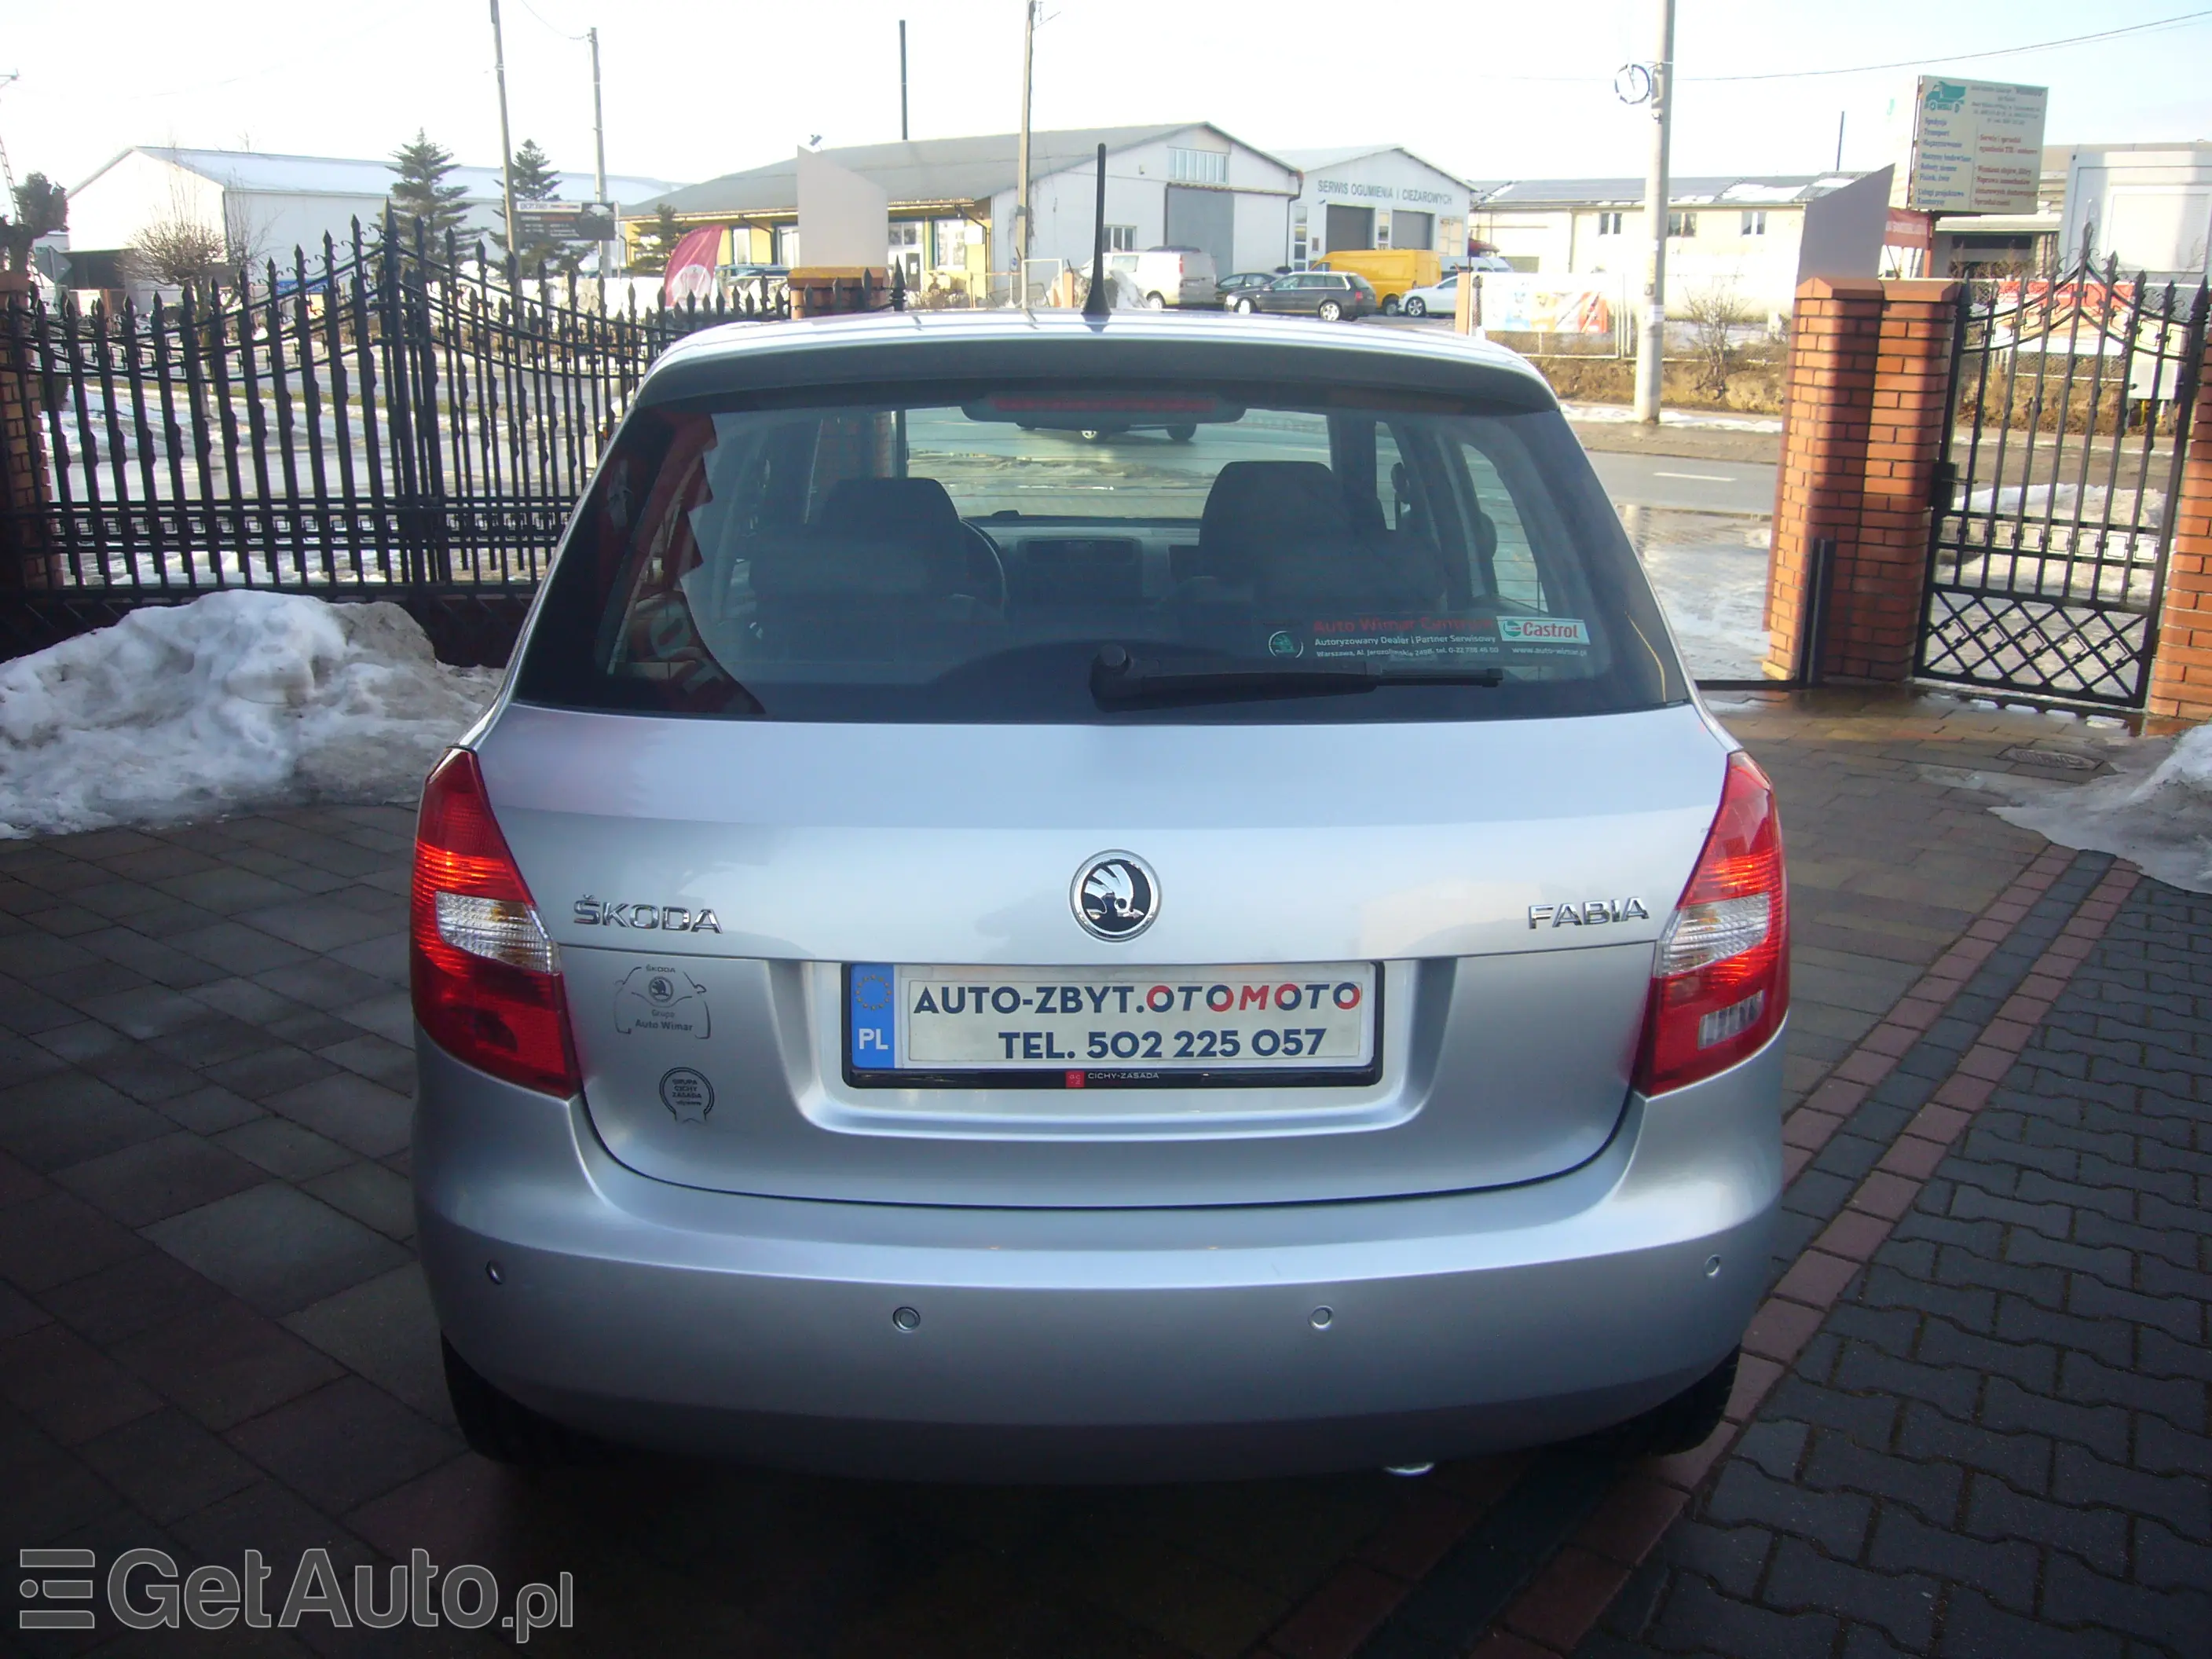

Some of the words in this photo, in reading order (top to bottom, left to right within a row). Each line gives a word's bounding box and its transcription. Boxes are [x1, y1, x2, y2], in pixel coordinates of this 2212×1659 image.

[1317, 179, 1348, 195] SERWIS
[1350, 183, 1393, 199] OGUMIENIA
[1314, 637, 1379, 647] Autoryzowany
[1380, 635, 1410, 645] Dealer
[1416, 635, 1448, 644] Partner
[1449, 634, 1496, 644] Serwisowy
[1522, 621, 1579, 639] Castrol
[573, 895, 723, 934] ŠKODA
[1528, 896, 1650, 929] FABIA
[645, 964, 676, 973] ŠKODA
[913, 982, 1361, 1015] AUTO-ZBYT.OTOMOTO
[635, 1019, 658, 1029] Auto
[661, 1021, 694, 1031] Wimar
[859, 1027, 889, 1050] PL
[998, 1031, 1076, 1060] TEL.
[1086, 1030, 1163, 1059] 502
[1173, 1029, 1241, 1058] 225
[1251, 1027, 1328, 1057] 057
